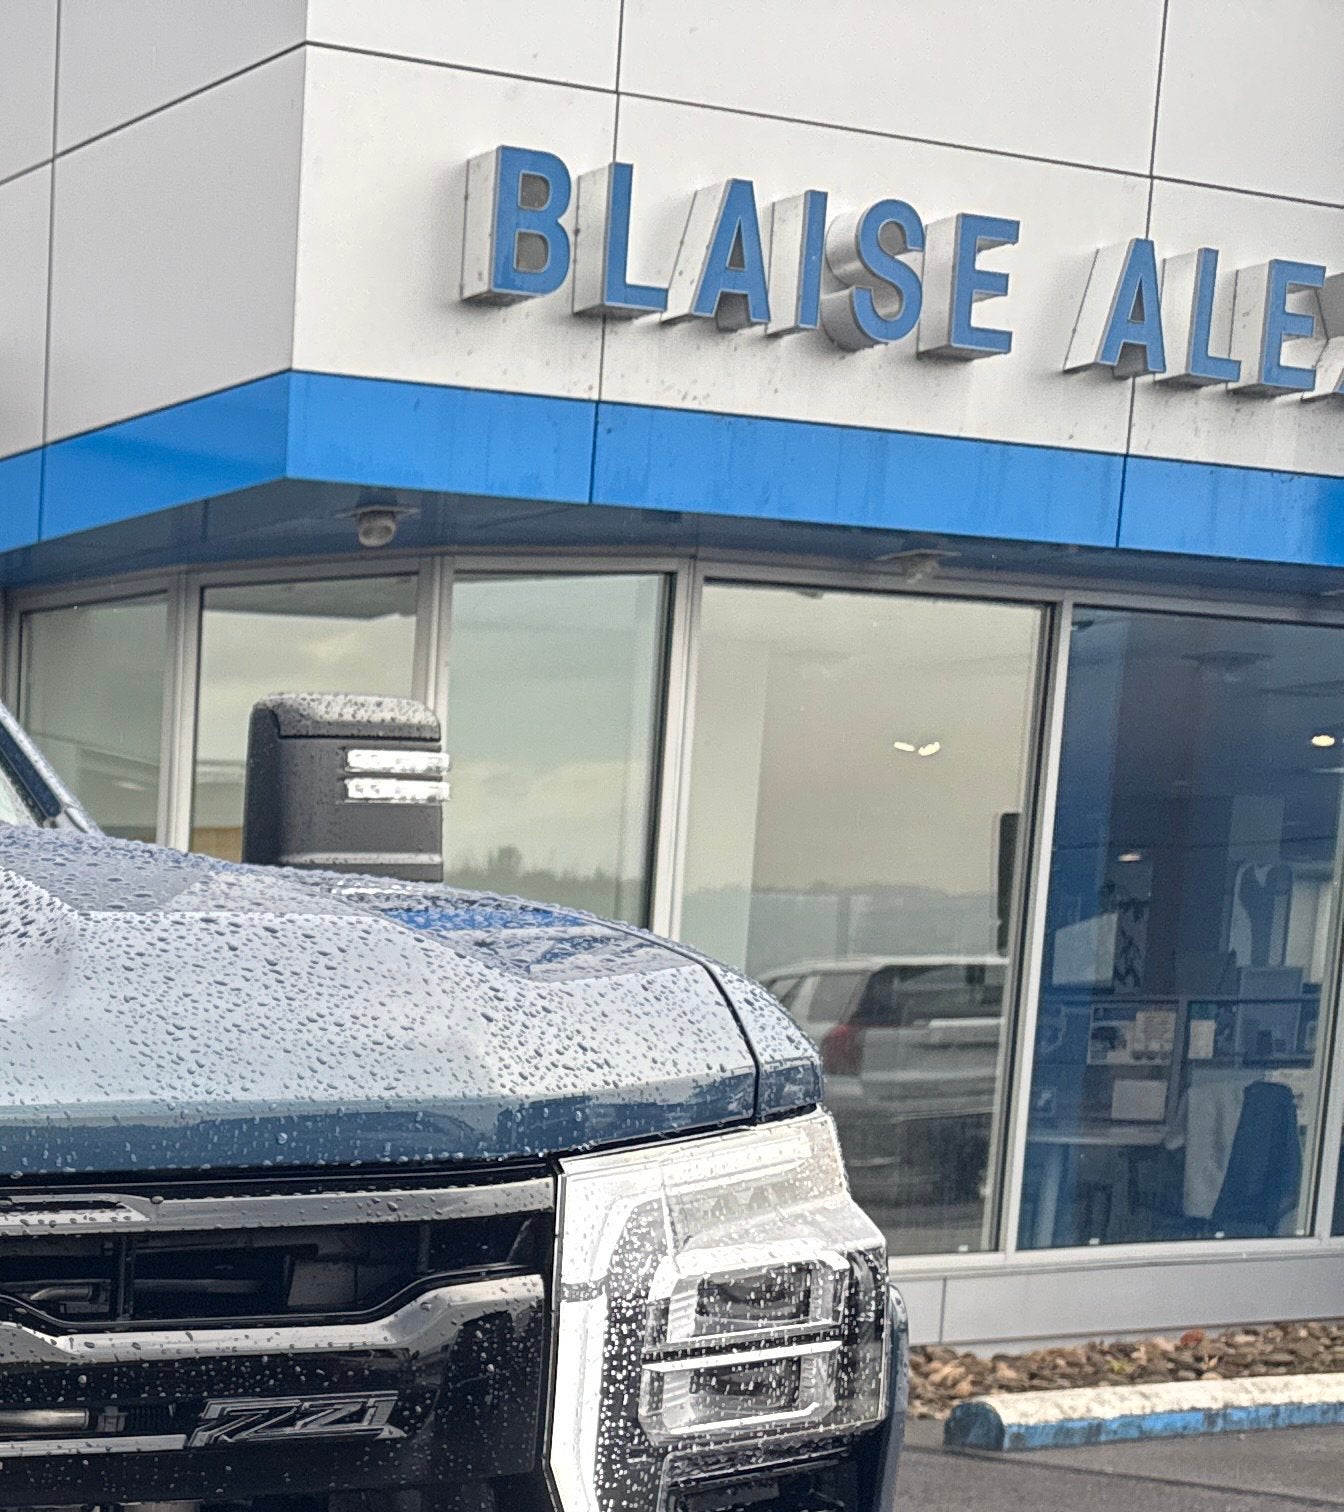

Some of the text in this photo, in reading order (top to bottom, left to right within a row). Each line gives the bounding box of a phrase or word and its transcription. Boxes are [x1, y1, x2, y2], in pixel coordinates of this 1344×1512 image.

[484, 144, 1344, 394] BLAISE ALE
[185, 1390, 408, 1447] Z71
